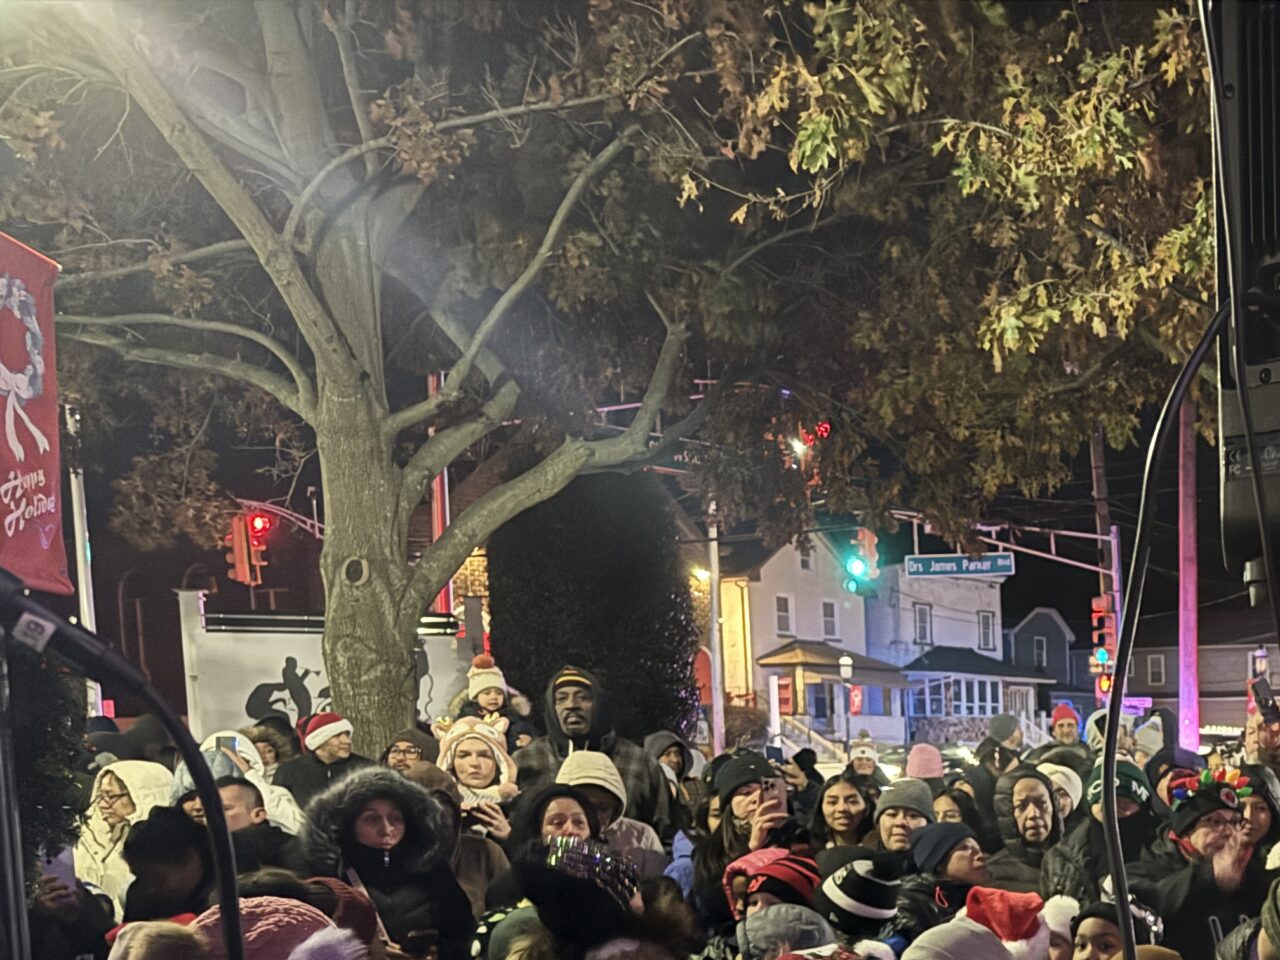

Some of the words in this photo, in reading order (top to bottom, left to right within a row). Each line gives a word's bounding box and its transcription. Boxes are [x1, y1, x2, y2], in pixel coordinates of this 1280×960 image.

[908, 561, 923, 572] Drs
[930, 561, 957, 571] James
[962, 559, 991, 570] Parker
